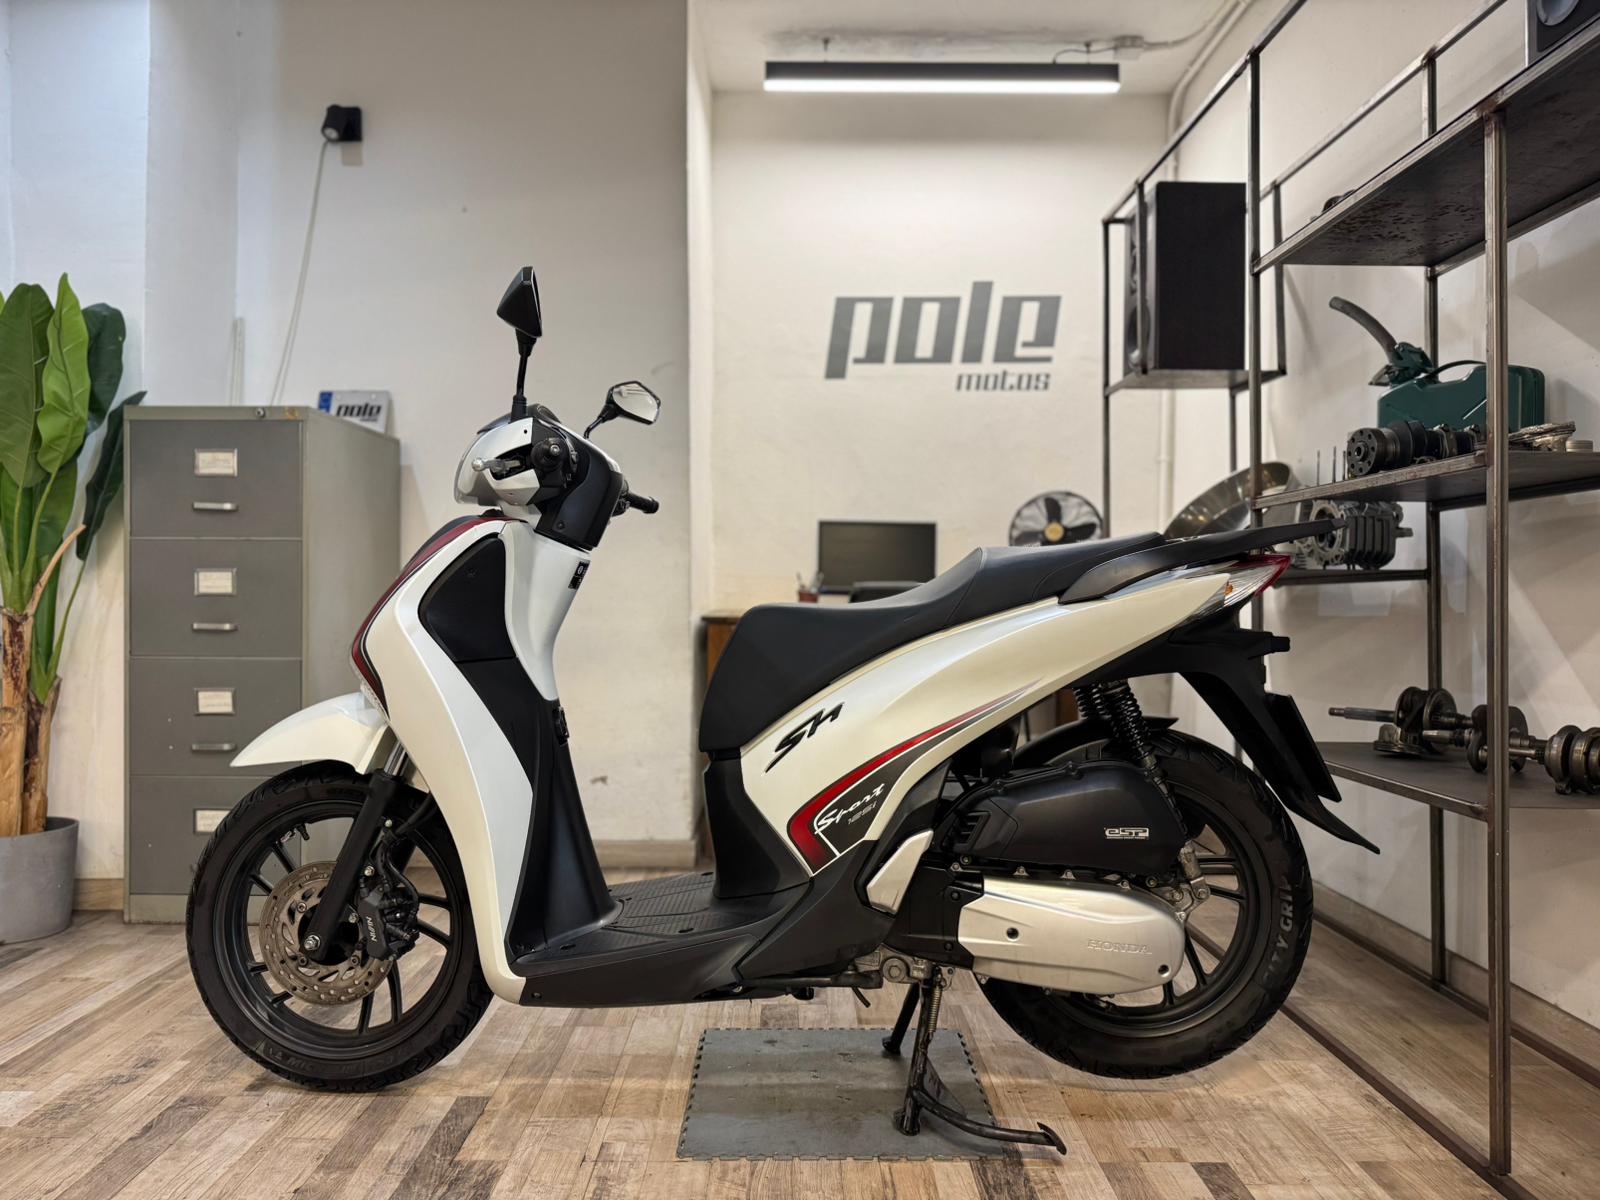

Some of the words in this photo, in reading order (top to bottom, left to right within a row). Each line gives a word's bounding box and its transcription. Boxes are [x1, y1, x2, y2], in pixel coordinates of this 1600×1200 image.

[825, 281, 1061, 379] pole
[956, 370, 1050, 391] motos
[765, 702, 845, 774] SH
[814, 783, 885, 835] Sport
[1087, 939, 1153, 955] HONDA
